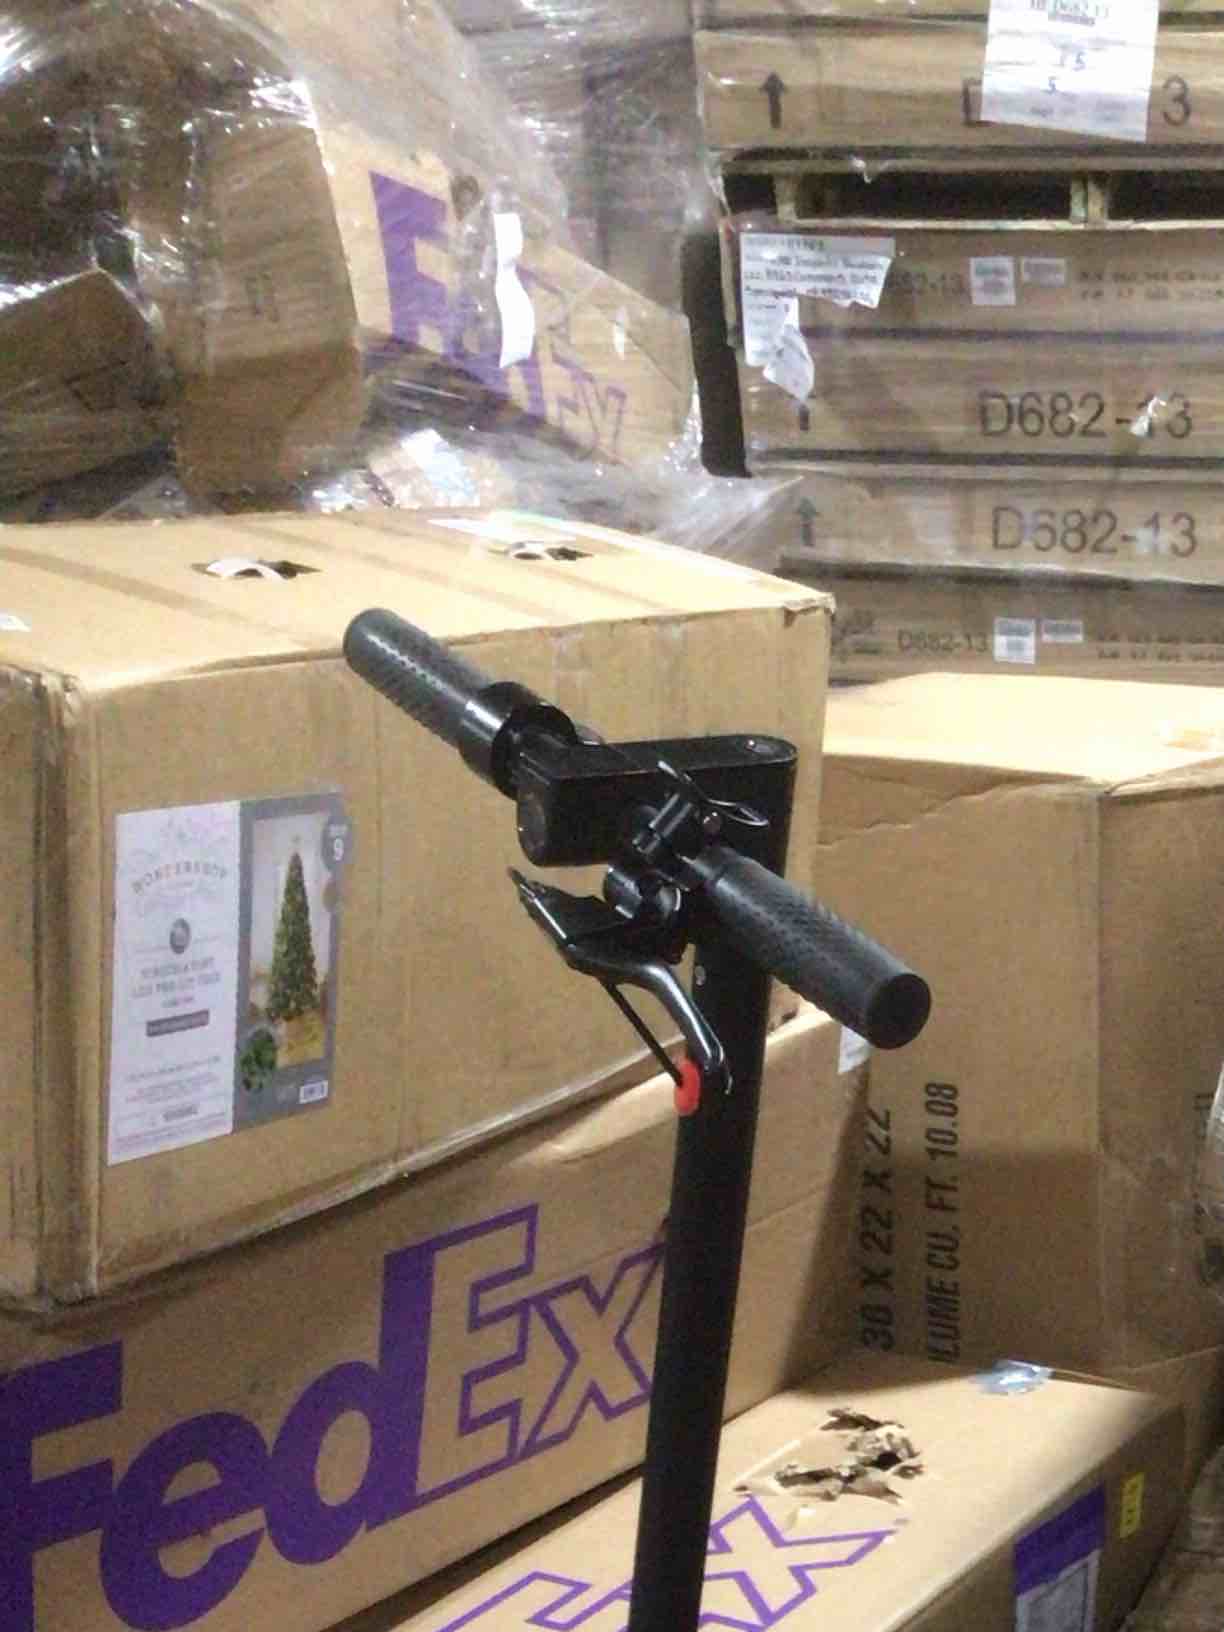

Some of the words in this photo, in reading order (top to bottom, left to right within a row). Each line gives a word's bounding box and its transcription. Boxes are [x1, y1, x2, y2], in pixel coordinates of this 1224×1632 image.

[978, 391, 1193, 440] D682-13
[992, 506, 1198, 558] D682-13
[925, 1081, 959, 1161] 10.08
[860, 1205, 893, 1254] 22
[926, 1225, 960, 1272] CU.
